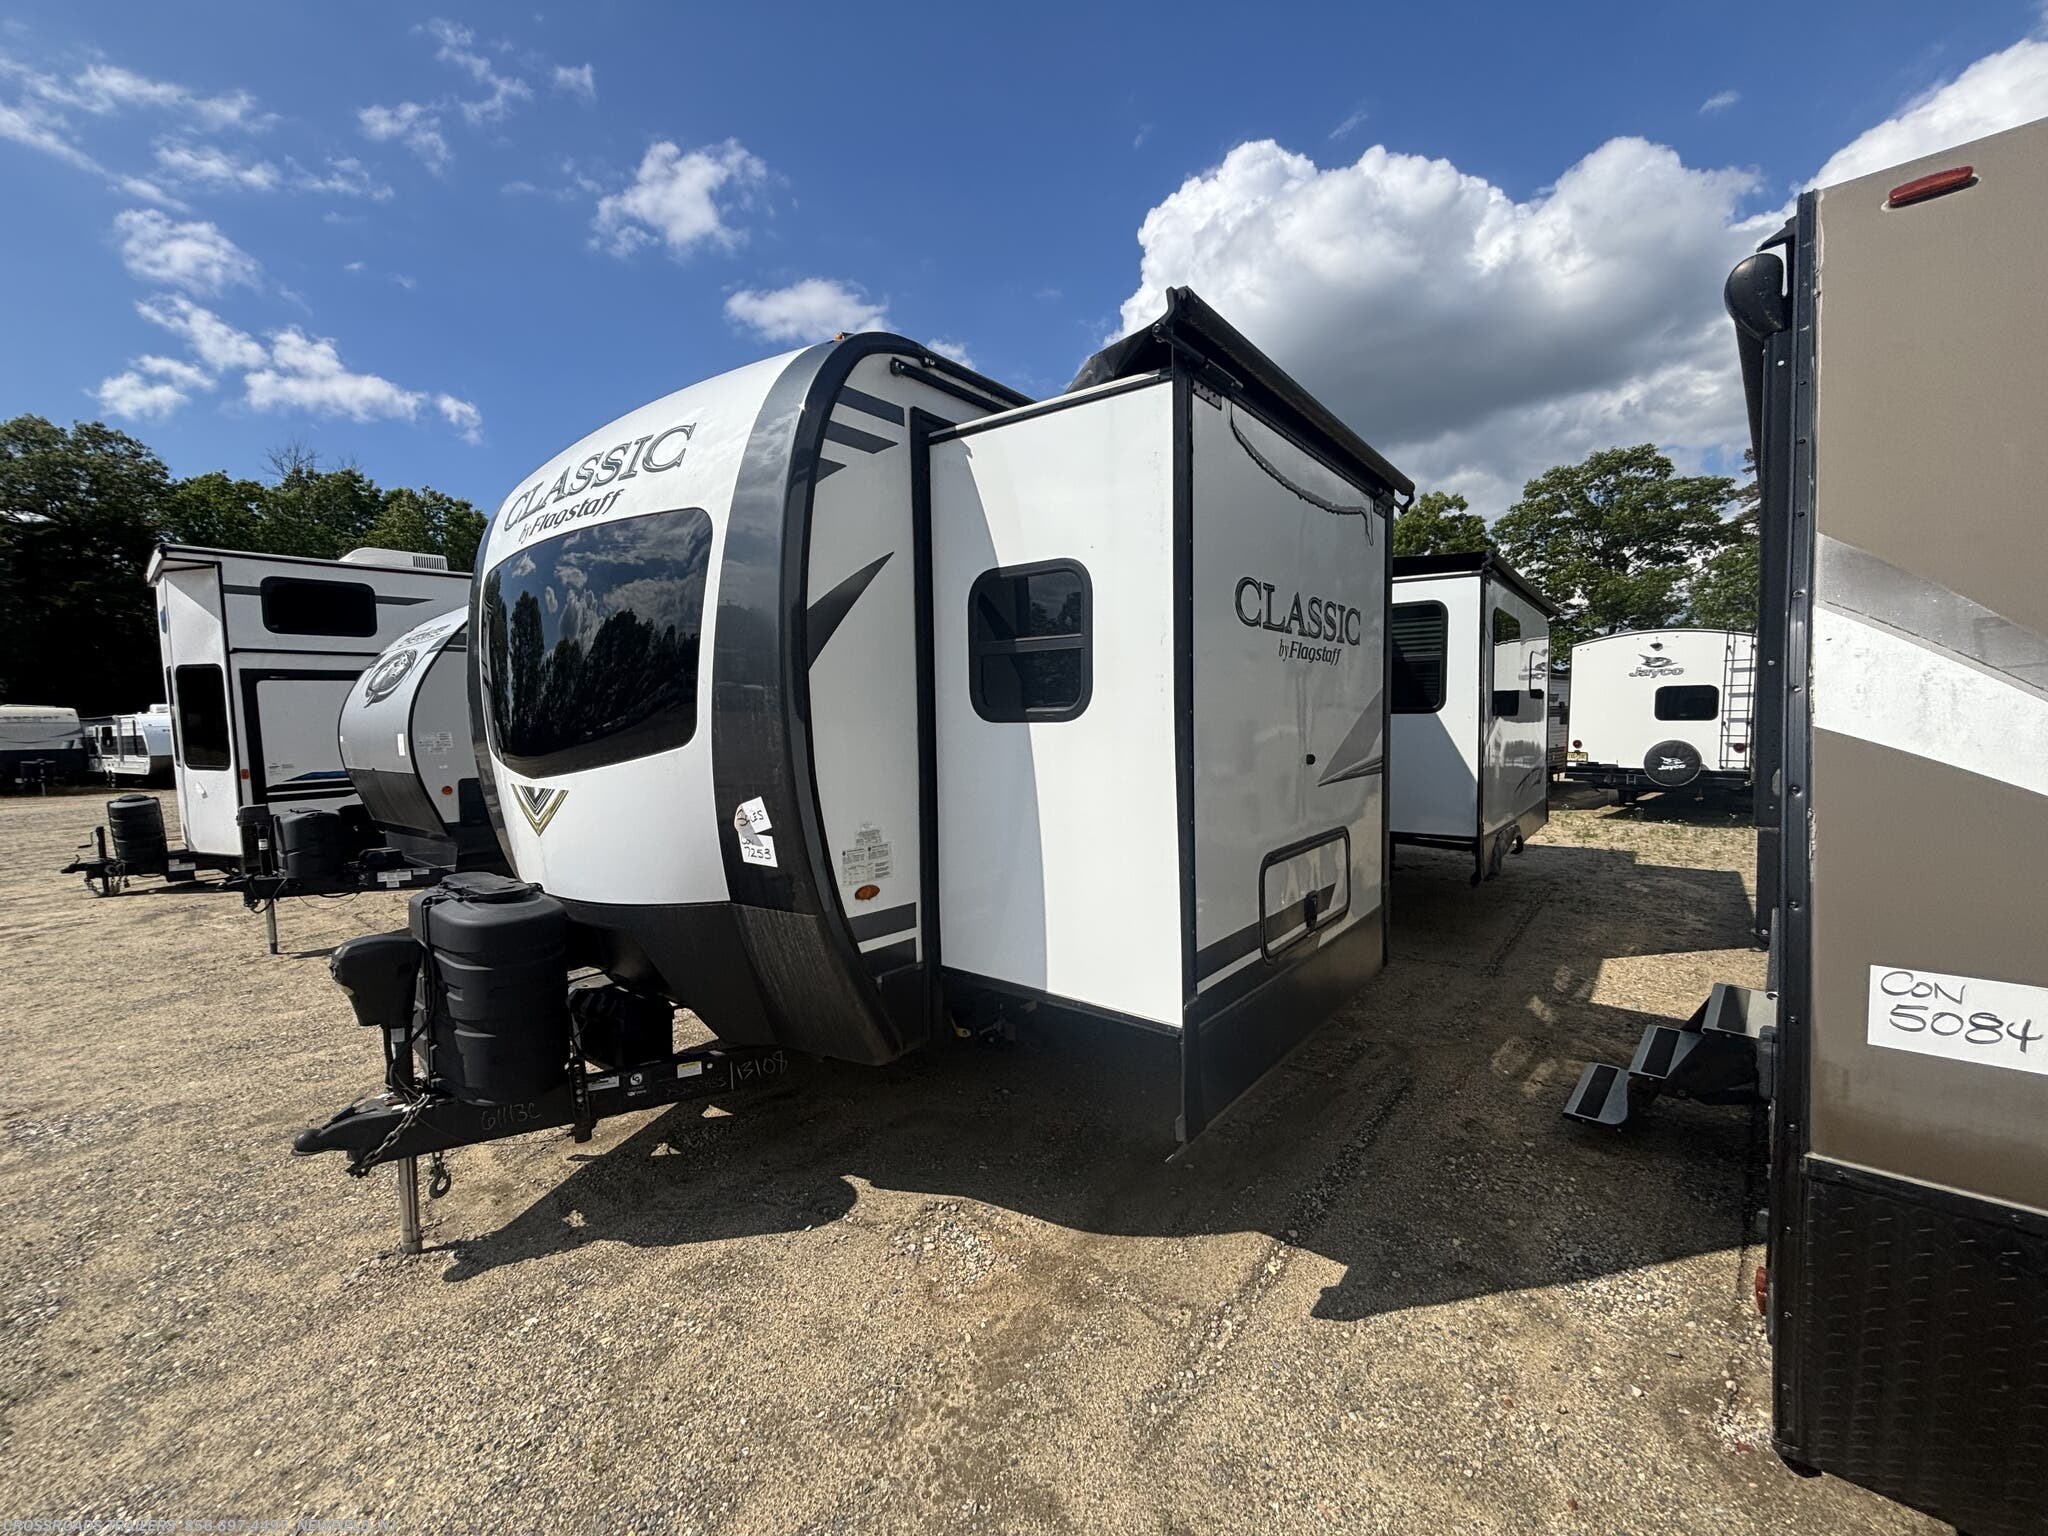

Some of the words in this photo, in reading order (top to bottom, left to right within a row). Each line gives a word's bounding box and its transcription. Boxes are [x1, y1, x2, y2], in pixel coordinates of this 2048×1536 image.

[504, 422, 697, 532] CLASSIC
[529, 489, 625, 536] Flagstaff
[1235, 576, 1361, 646] CLASSIC
[1289, 641, 1342, 666] Flagstaff
[1628, 667, 1684, 678] Jayco
[743, 845, 772, 860] 7253
[1889, 1004, 2044, 1054] 5084
